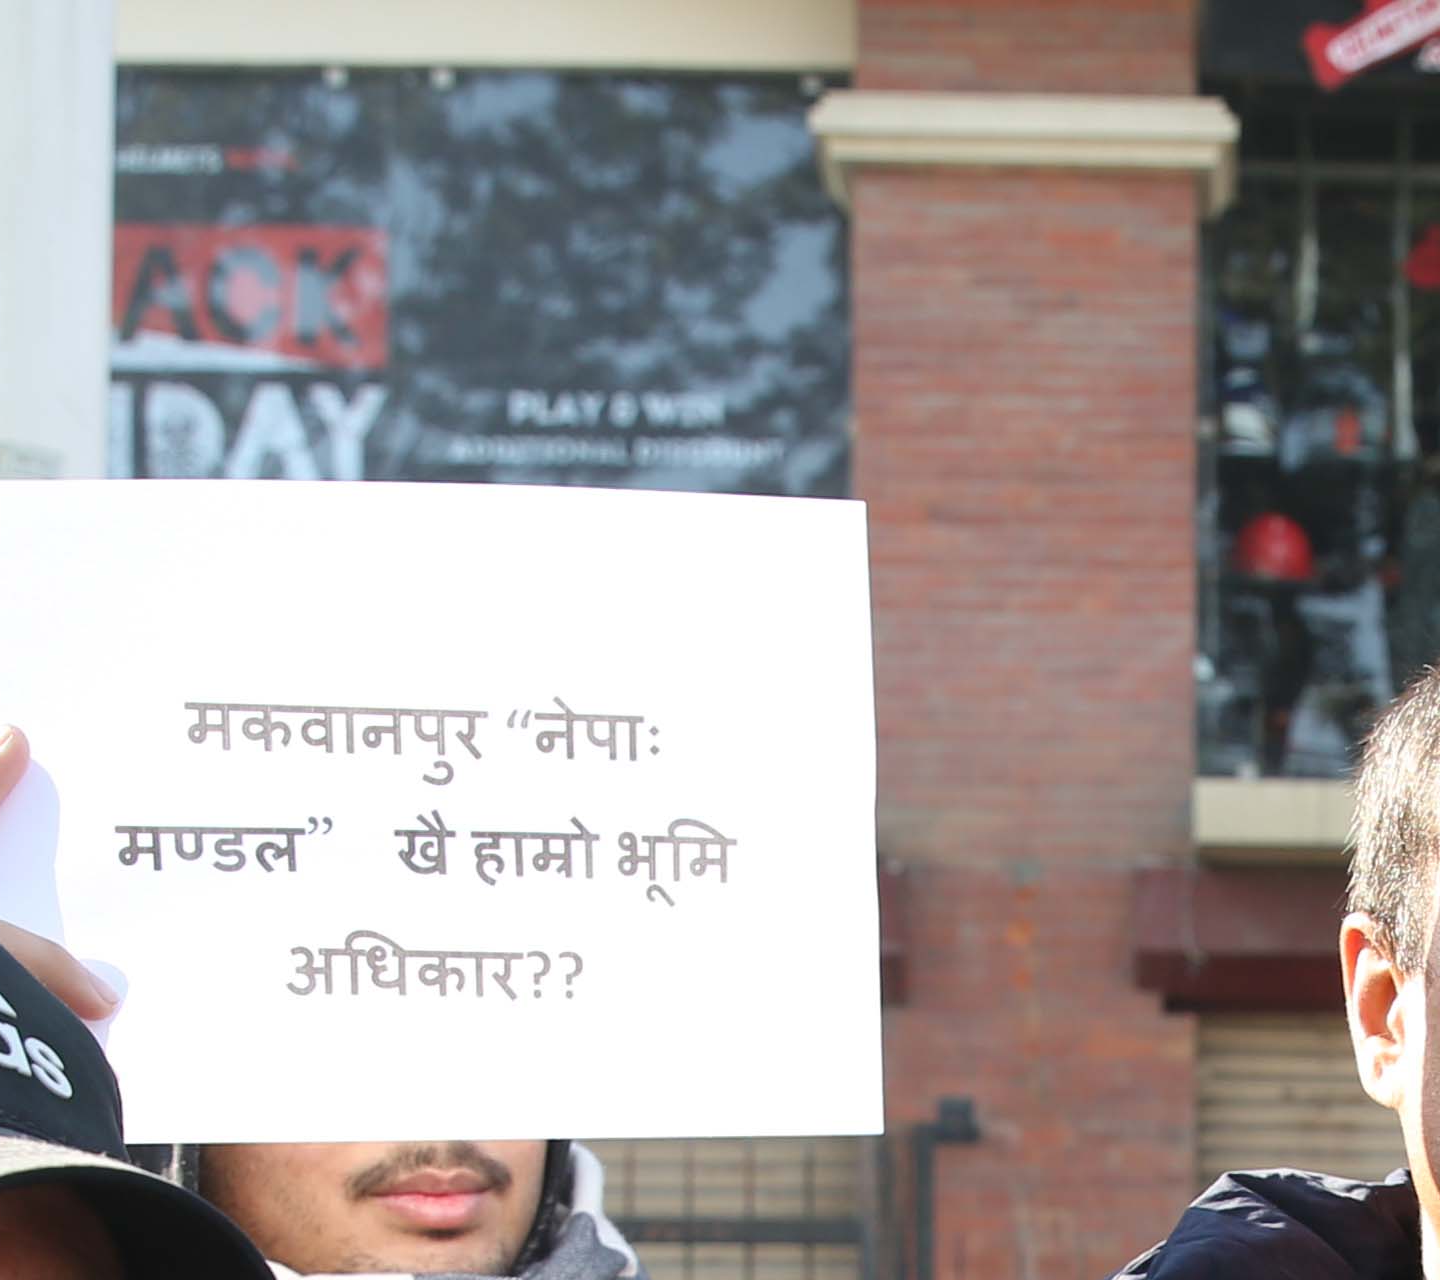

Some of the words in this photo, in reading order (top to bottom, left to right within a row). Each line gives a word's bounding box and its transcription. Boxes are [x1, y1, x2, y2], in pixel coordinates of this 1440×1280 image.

[117, 246, 362, 346] ACK
[110, 380, 388, 480] IDAY
[506, 388, 608, 426] PLAY
[185, 702, 488, 785] मकवानपुर
[394, 810, 456, 874] खै
[471, 817, 599, 885] हाम्रो
[618, 819, 736, 906] भूमि
[287, 930, 582, 1000] अधिकार??
